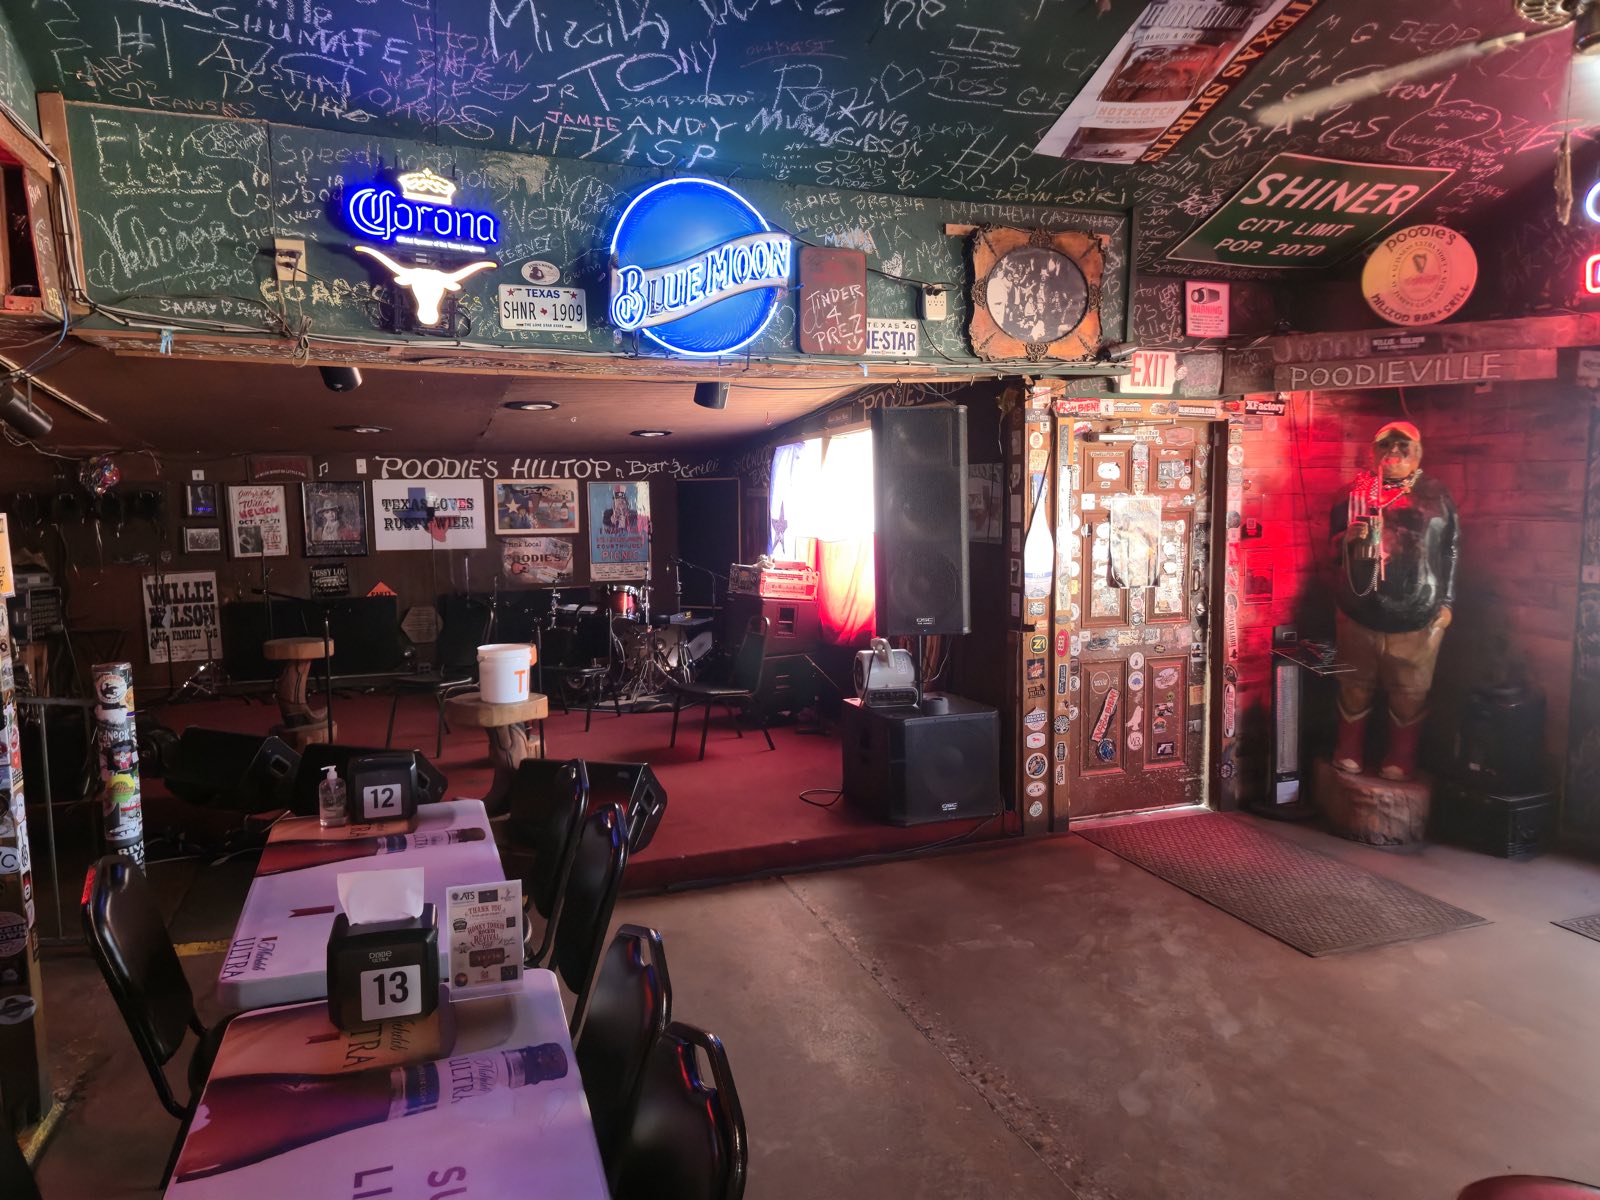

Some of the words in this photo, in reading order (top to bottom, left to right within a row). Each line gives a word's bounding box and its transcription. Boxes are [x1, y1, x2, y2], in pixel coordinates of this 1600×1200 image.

[1221, 0, 1314, 78] TEXAS
[557, 38, 718, 111] TONY
[546, 111, 621, 131] JAMIE
[627, 115, 738, 142] ANDY
[1141, 82, 1229, 163] SPIRITS
[1241, 173, 1420, 216] SHINER
[350, 188, 497, 241] Corona
[1238, 218, 1293, 233] CITY
[1293, 222, 1355, 238] LIMIT
[1214, 238, 1260, 253] POP.
[1268, 244, 1327, 257] 2070
[526, 289, 560, 299] TEXAS
[611, 262, 706, 331] BLUE
[700, 239, 792, 291] MOON
[503, 302, 537, 320] SHNR
[552, 303, 583, 321] 1909
[826, 305, 842, 325] 4
[1191, 305, 1223, 315] WARNING
[812, 313, 863, 352] PREZ
[883, 331, 917, 351] STAR
[1130, 353, 1169, 388] EXIT
[1290, 353, 1501, 391] POODIEVILLE
[1245, 400, 1285, 414] XFactory
[374, 455, 499, 479] POODIE'S
[511, 458, 611, 479] HILLTOP
[625, 459, 669, 478] Bar
[239, 505, 280, 519] NELSON
[382, 498, 427, 513] TEXAS
[434, 498, 474, 511] LOVES
[601, 550, 639, 560] PICNIC
[333, 567, 346, 576] LOU
[147, 581, 213, 604] WILLIE
[149, 604, 216, 630] NELSON
[172, 628, 201, 641] FAMILY
[370, 787, 395, 809] 12
[460, 891, 475, 900] ATS
[468, 905, 489, 915] THANK
[491, 904, 502, 912] YOU
[467, 922, 486, 935] HONKY
[474, 933, 500, 944] REVIVAL
[221, 936, 256, 980] ULTRA
[372, 970, 409, 1006] 13
[448, 1056, 475, 1105] ULTRA
